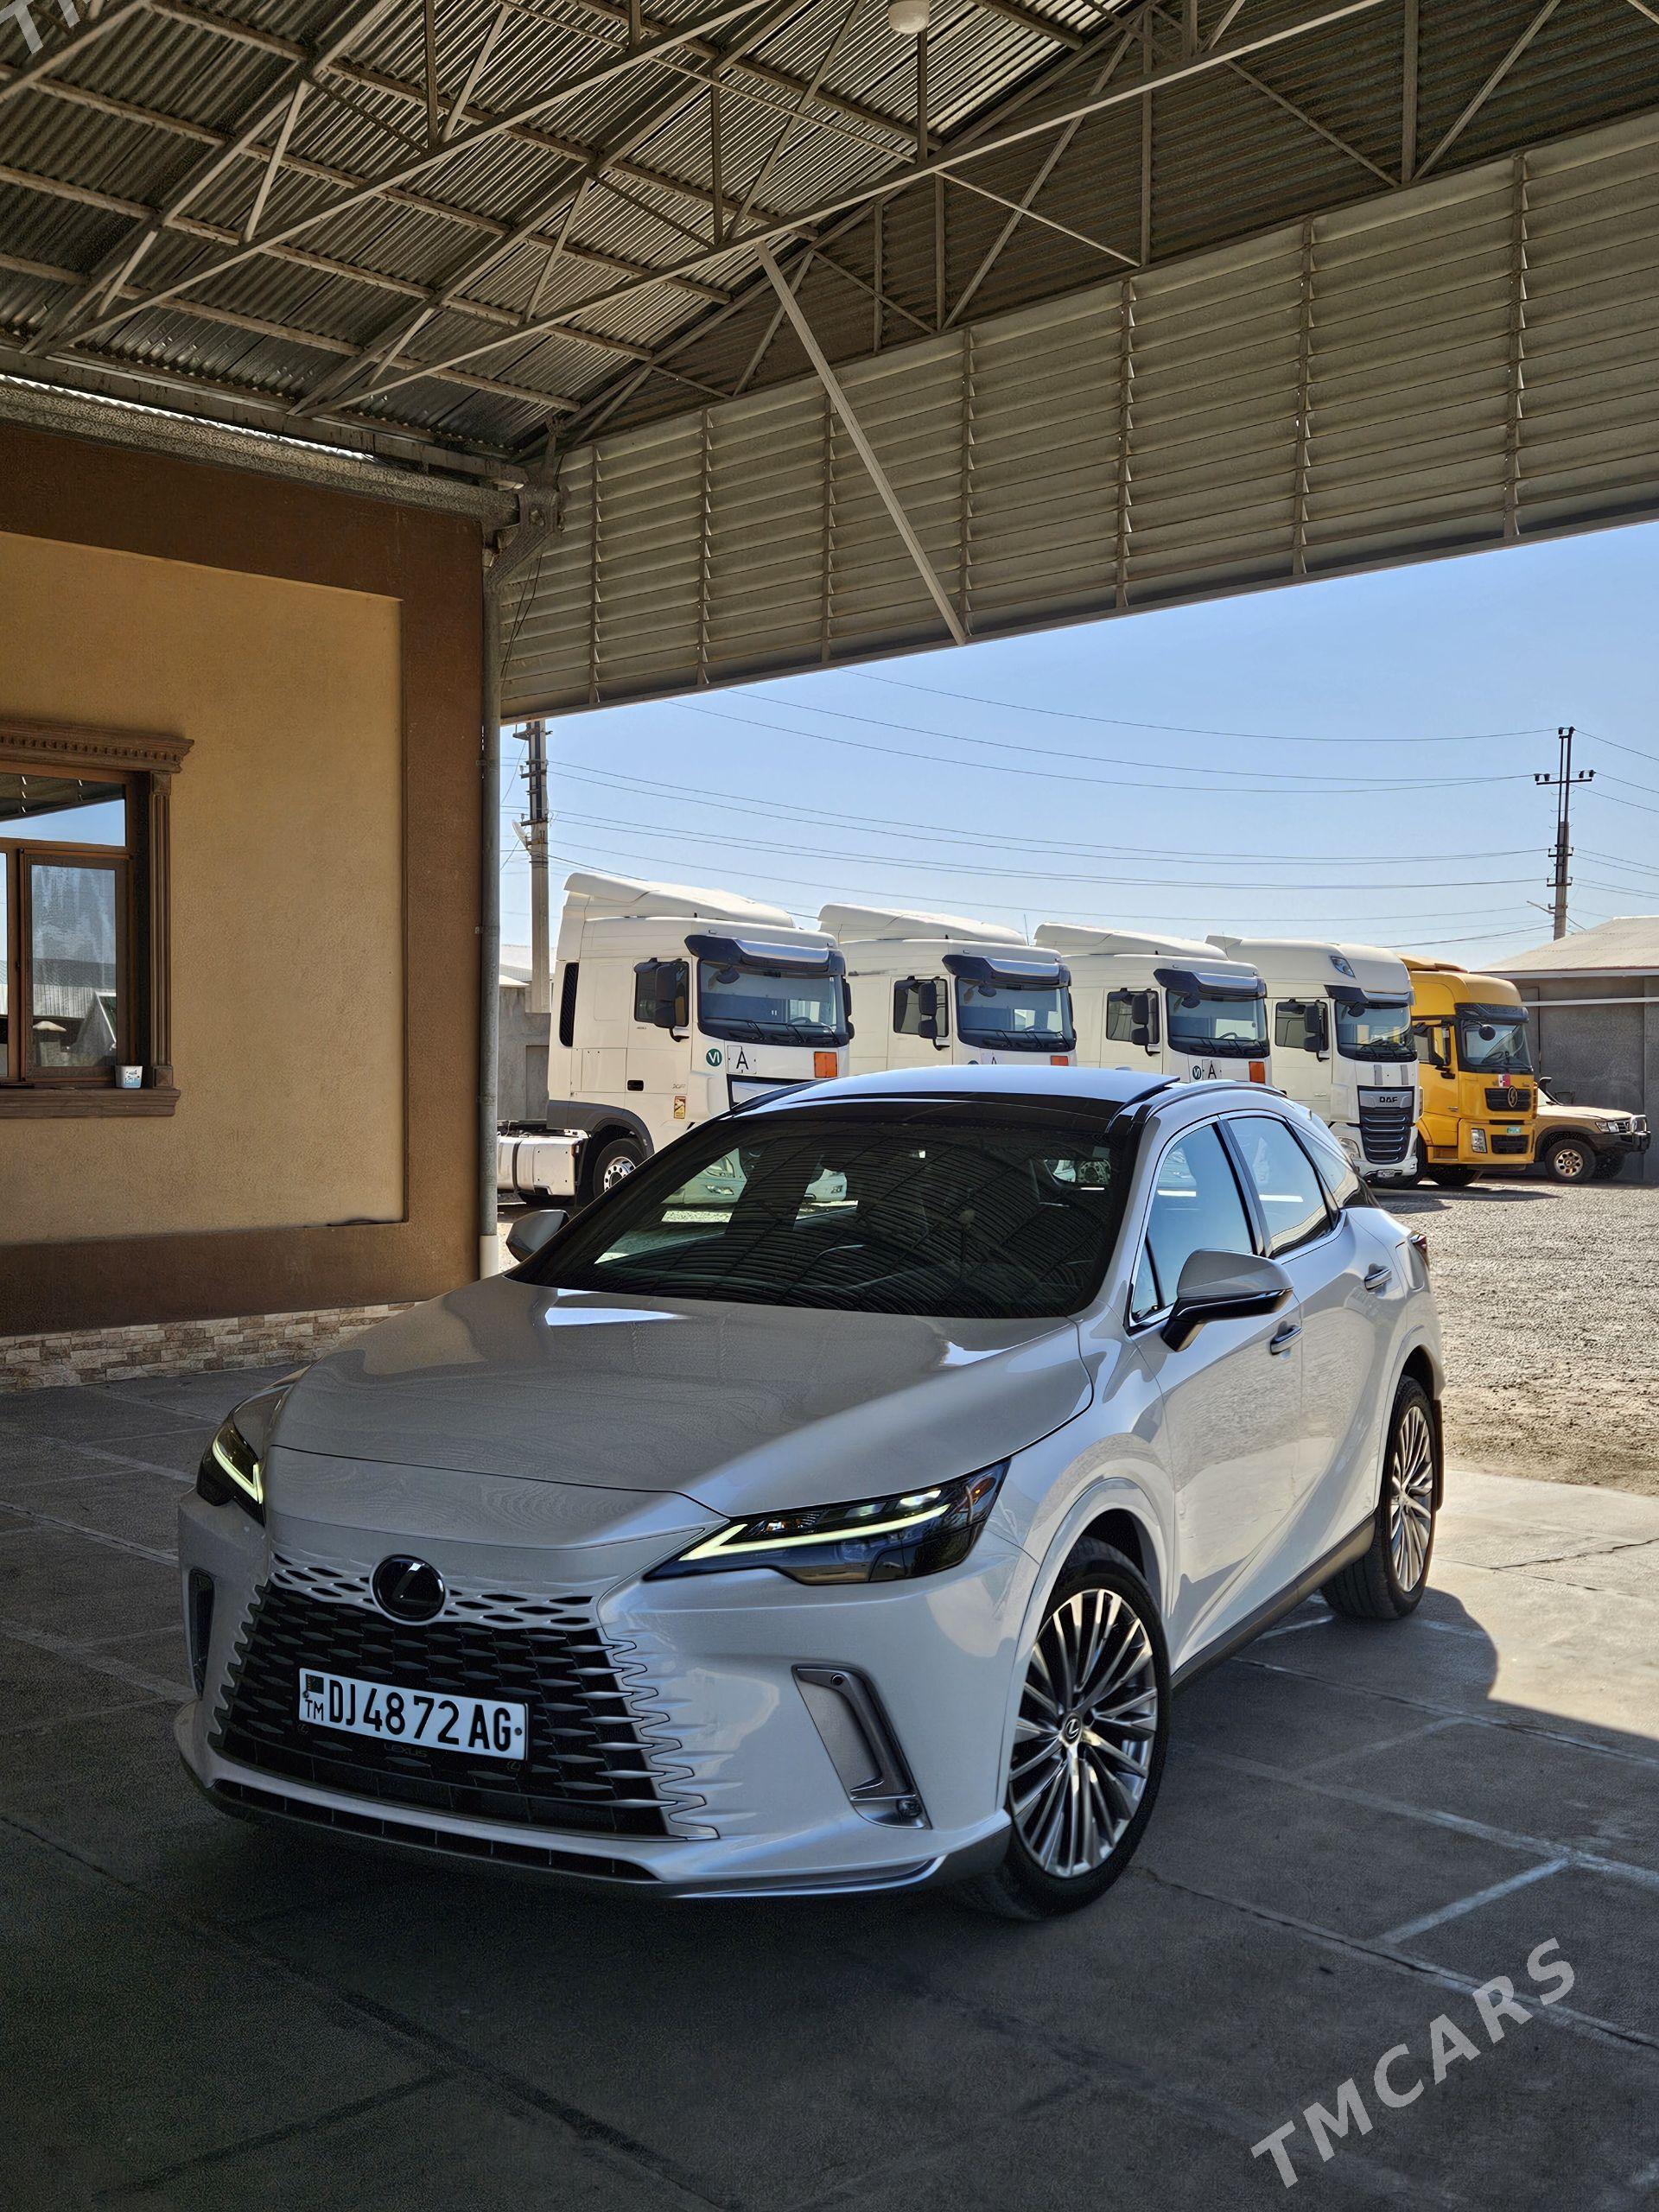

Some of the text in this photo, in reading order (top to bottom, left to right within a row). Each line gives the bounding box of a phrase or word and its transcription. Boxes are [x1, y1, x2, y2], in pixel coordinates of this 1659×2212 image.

[735, 1050, 749, 1070] A
[1207, 1063, 1217, 1079] A
[305, 1699, 325, 1721] TM
